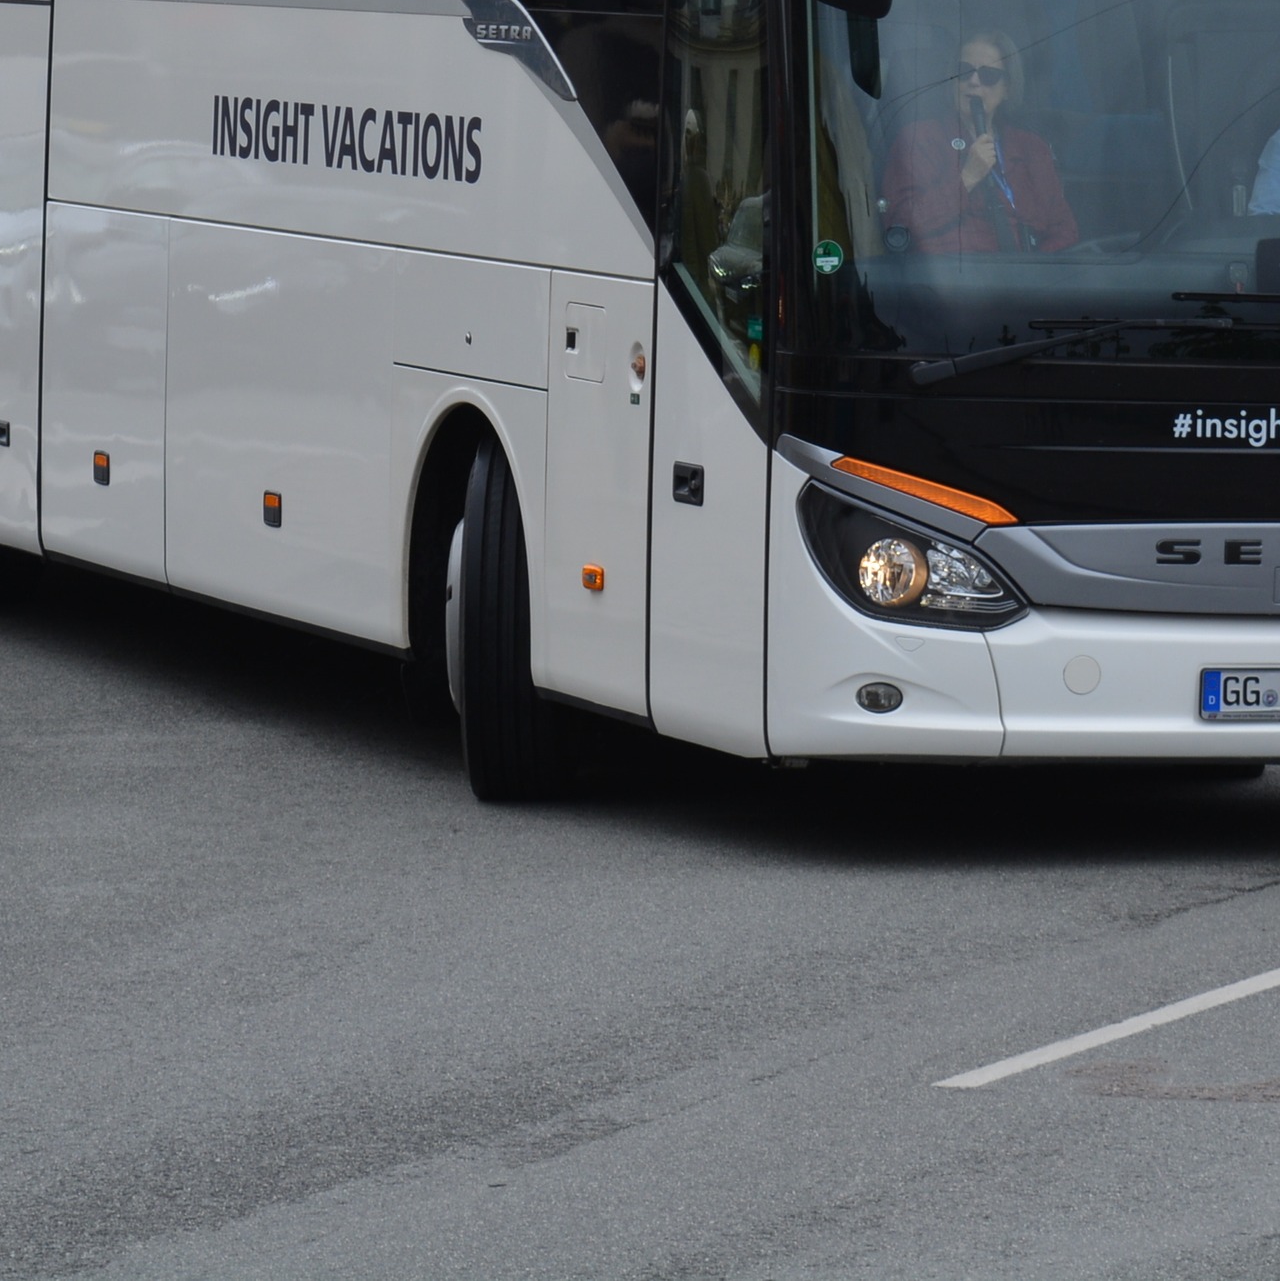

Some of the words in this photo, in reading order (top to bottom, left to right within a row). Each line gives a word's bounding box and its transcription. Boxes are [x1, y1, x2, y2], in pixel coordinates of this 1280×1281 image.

[476, 24, 532, 39] SETRA
[212, 95, 315, 165] INSIGHT
[321, 104, 483, 184] VACATIONS
[1222, 676, 1261, 706] GG
